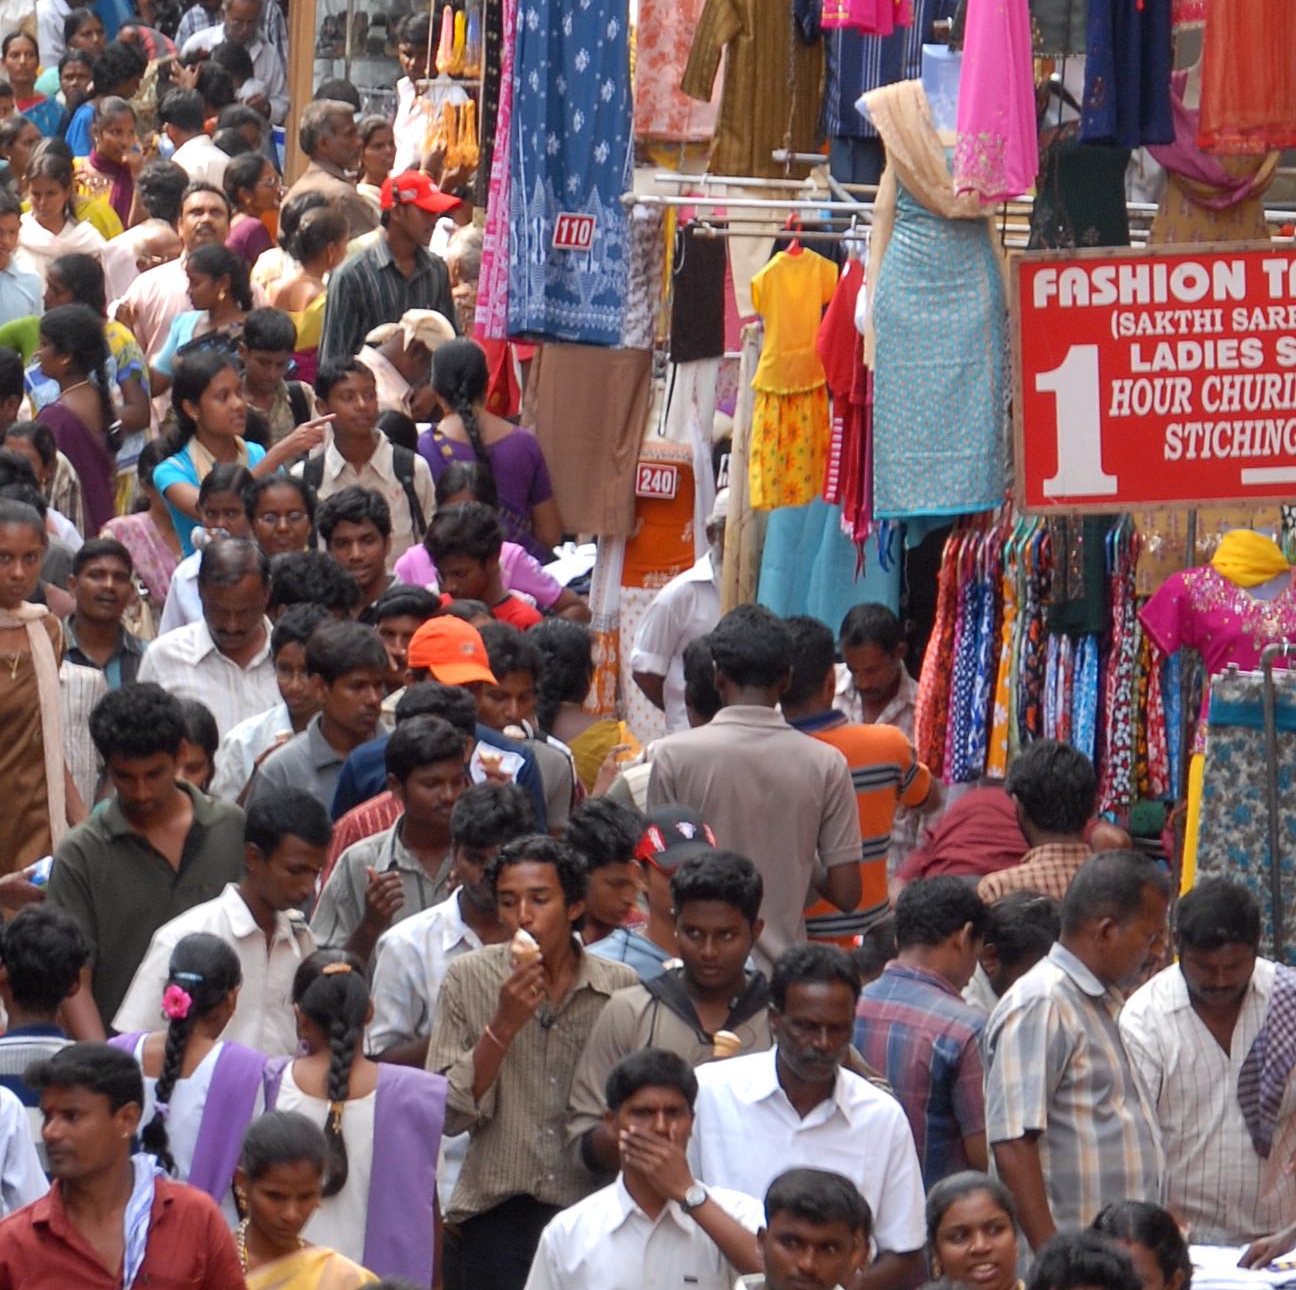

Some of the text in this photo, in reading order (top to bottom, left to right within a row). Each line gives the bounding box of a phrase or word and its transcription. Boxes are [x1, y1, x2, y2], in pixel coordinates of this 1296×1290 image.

[559, 218, 591, 239] 110
[1032, 257, 1296, 308] FASHION T
[1129, 337, 1264, 374] LADIES
[1108, 371, 1296, 418] HOUR CHURI
[1034, 343, 1118, 498] 1
[640, 469, 673, 493] 240
